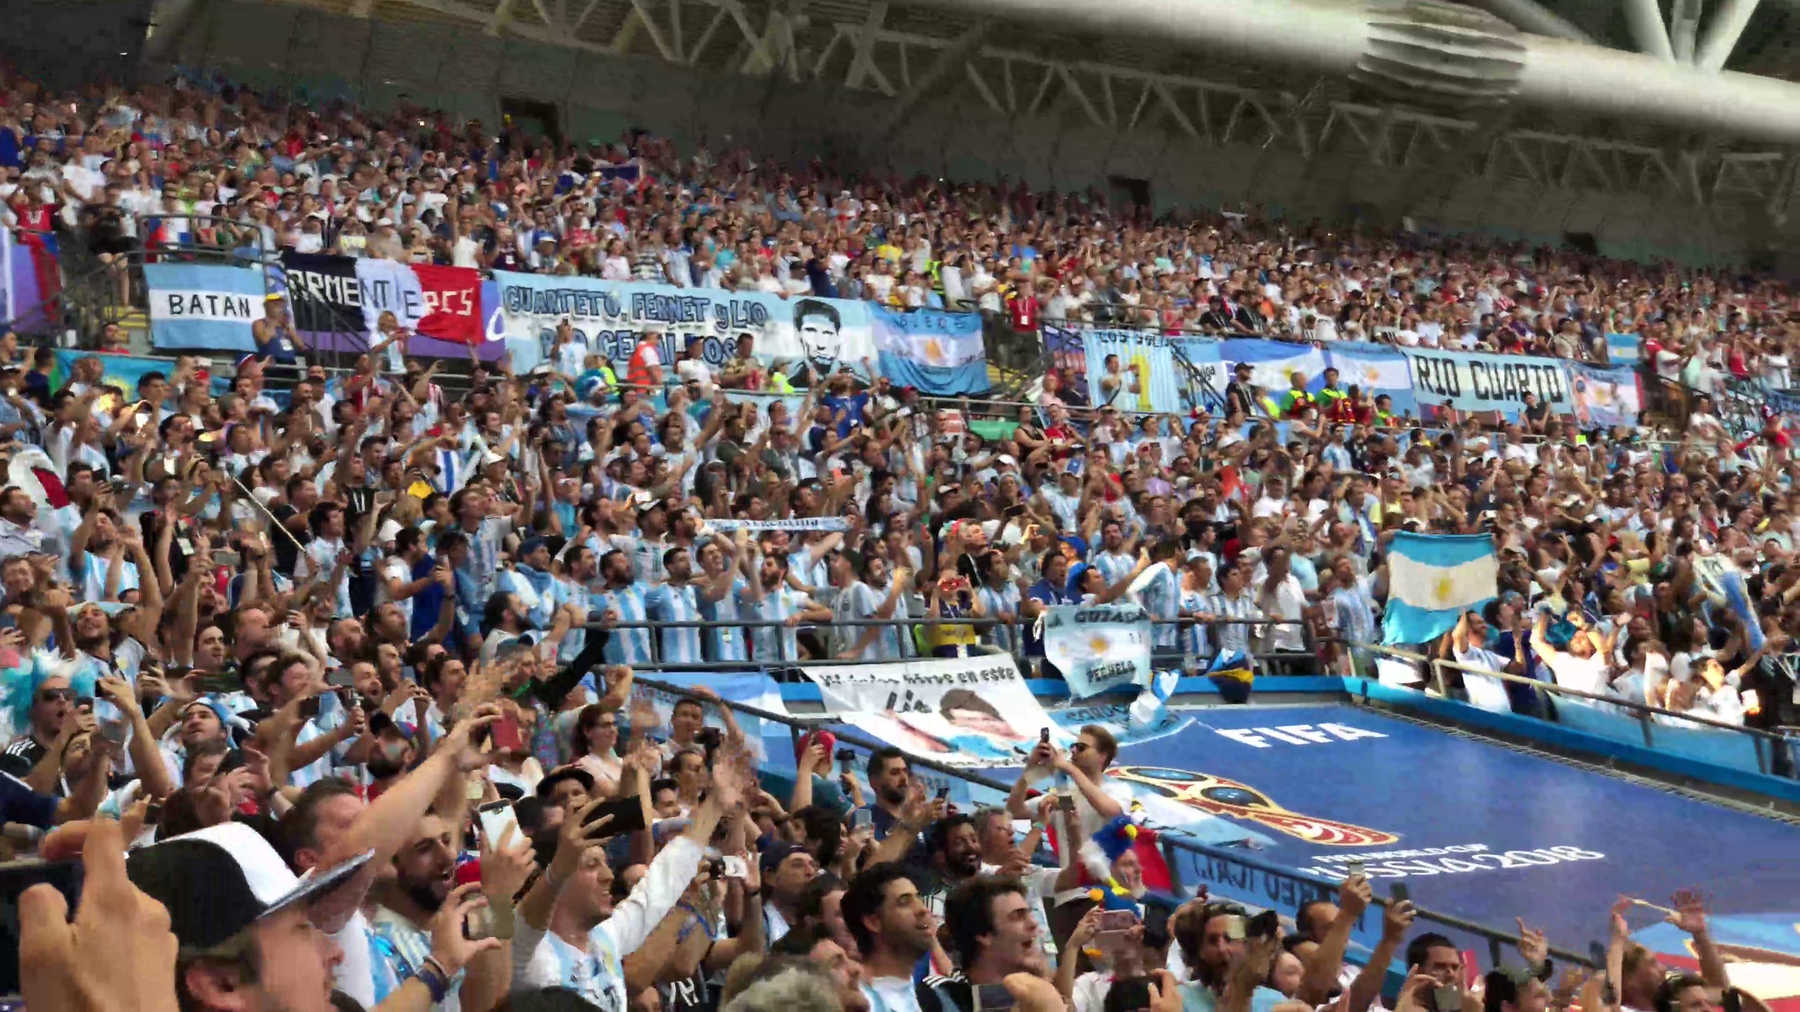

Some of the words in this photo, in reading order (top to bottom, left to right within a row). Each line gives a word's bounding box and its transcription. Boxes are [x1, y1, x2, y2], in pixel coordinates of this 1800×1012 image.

[168, 294, 250, 317] BATAN
[632, 292, 710, 323] FERNET
[1414, 354, 1461, 398] RIO
[1468, 360, 1564, 403] CUARTO
[1214, 722, 1391, 749] FIFA
[1471, 845, 1606, 869] 2018
